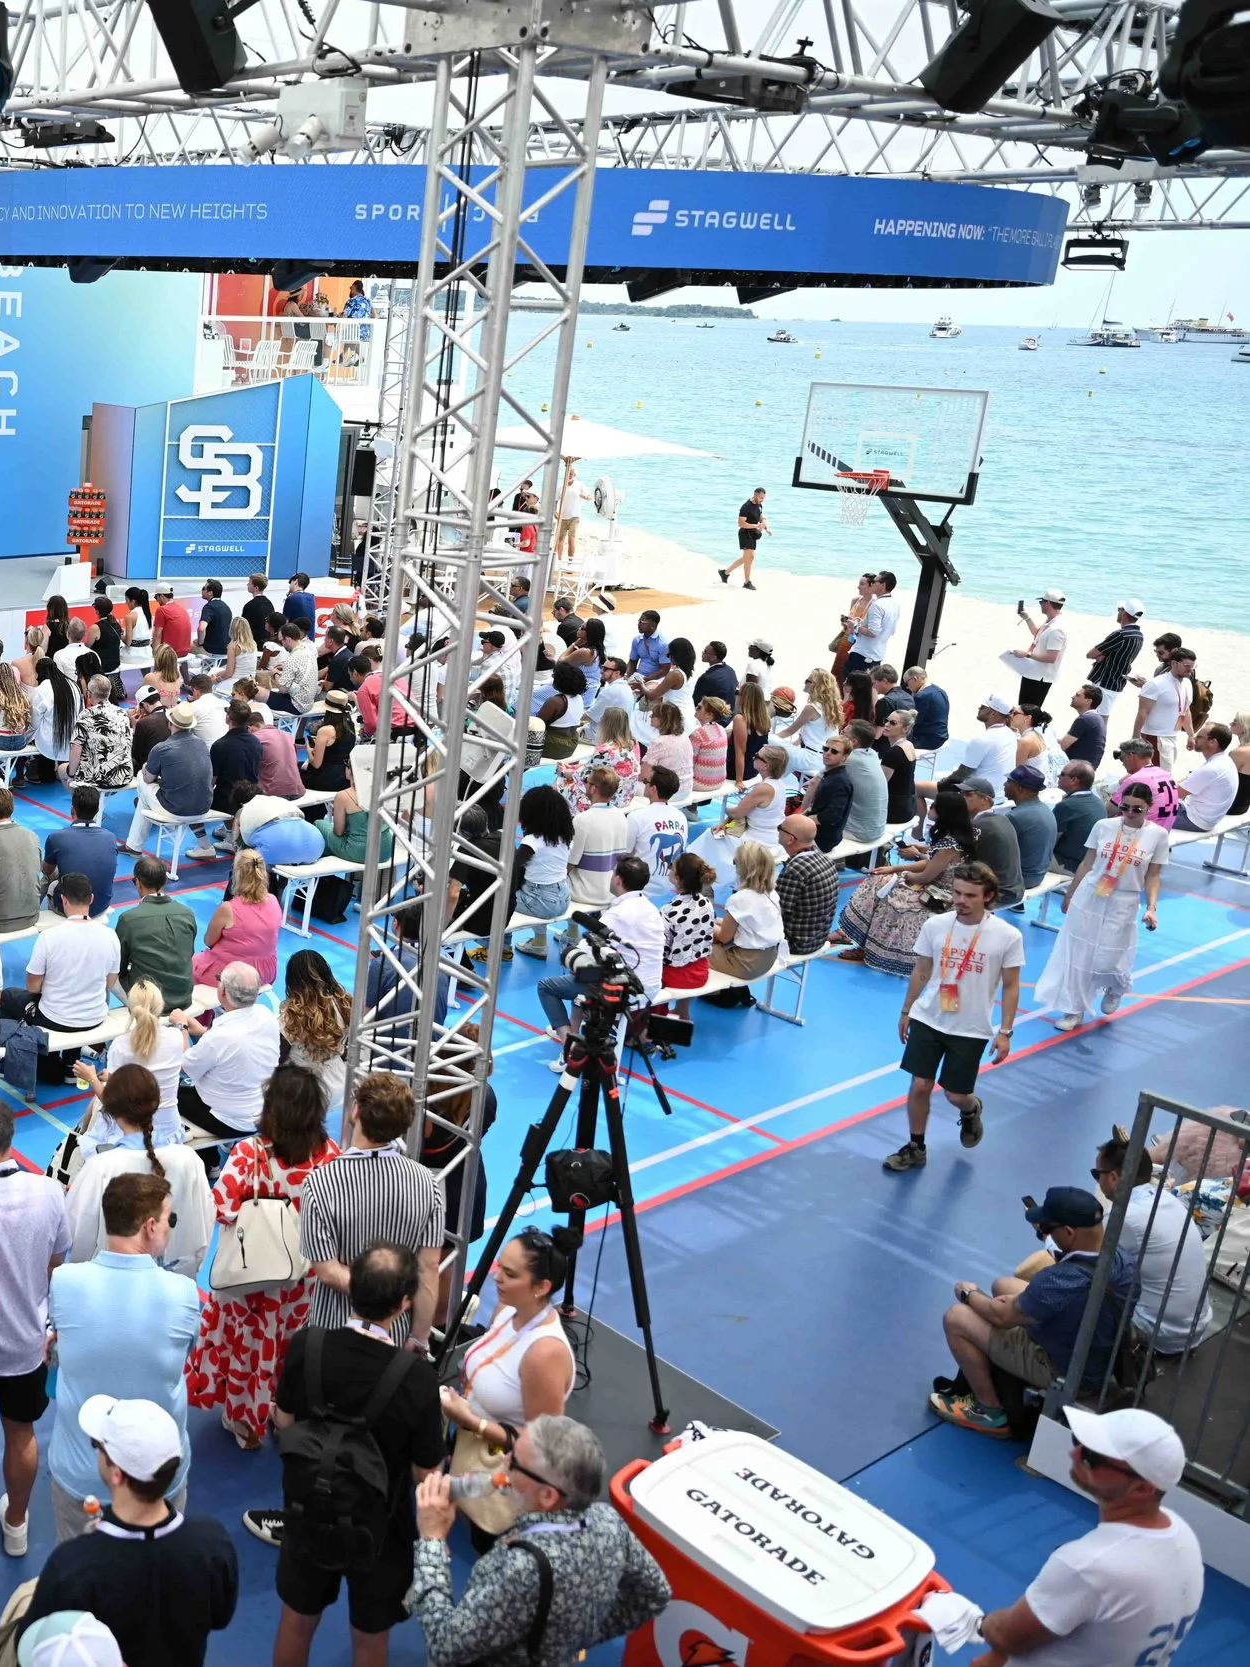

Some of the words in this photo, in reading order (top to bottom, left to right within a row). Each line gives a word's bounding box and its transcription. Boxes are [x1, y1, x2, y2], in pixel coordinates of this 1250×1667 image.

[11, 205, 35, 221] AND
[37, 203, 121, 220] INNOVATION
[125, 203, 145, 219] TO
[150, 203, 186, 219] NEW
[190, 203, 268, 219] HEIGHTS
[354, 203, 420, 221] SPOR
[674, 209, 797, 231] STAGWELL
[874, 217, 956, 239] HAPPENING
[957, 222, 985, 241] NOW:
[197, 545, 245, 553] STAGWELL
[654, 820, 685, 833] PARRA
[1103, 842, 1146, 856] SORT
[1100, 851, 1141, 867] BEAH
[734, 1466, 876, 1561] GATORADE
[685, 1488, 830, 1587] GATORADE
